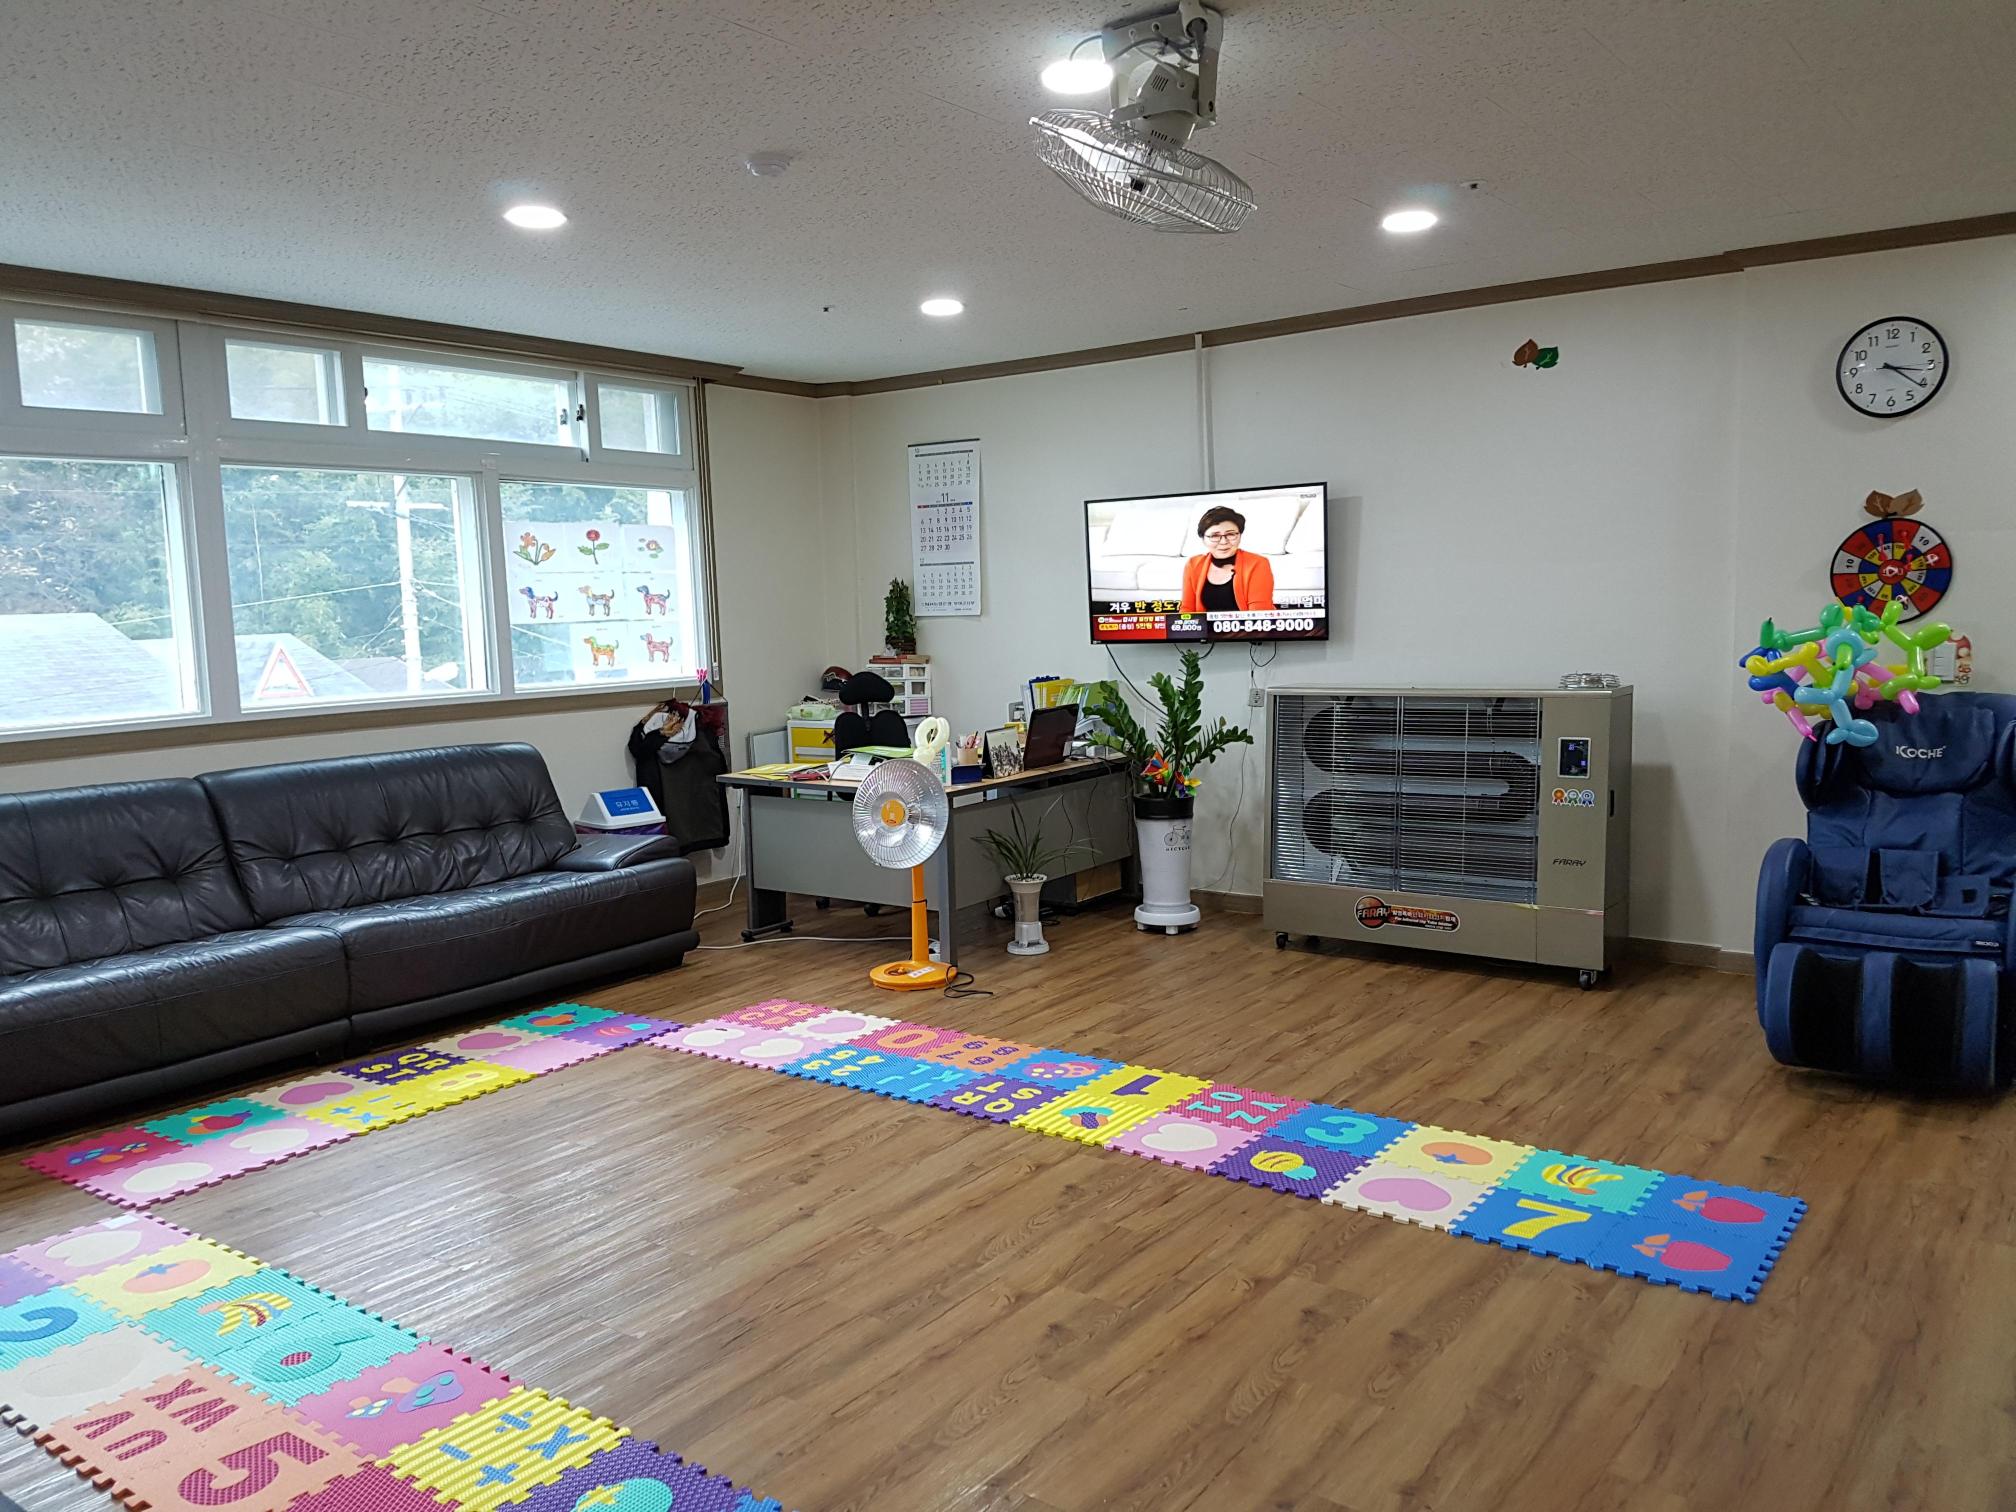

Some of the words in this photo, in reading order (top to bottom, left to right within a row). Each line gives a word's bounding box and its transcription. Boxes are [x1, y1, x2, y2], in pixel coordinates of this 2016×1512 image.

[1886, 328, 1900, 340] 12
[1910, 332, 1915, 342] 1
[1868, 336, 1879, 347] 11
[1922, 342, 1931, 353] 2
[1855, 350, 1867, 361] 10
[1928, 360, 1936, 370] 3
[1850, 368, 1858, 378] 9
[1920, 377, 1928, 388] 4
[1855, 384, 1863, 394] 8
[1868, 394, 1876, 404] 7
[1905, 390, 1914, 401] 5
[1886, 396, 1896, 407] 6
[942, 493, 949, 502] 11
[1135, 600, 1146, 613] 반
[1896, 745, 1944, 759] KOCHE
[828, 1050, 857, 1060] 5
[857, 1055, 885, 1064] 4
[398, 1053, 429, 1065] Q
[416, 1058, 450, 1070] R
[802, 1060, 831, 1070] 3
[360, 1064, 392, 1073] S
[385, 1068, 418, 1079] T
[831, 1065, 862, 1076] 2
[976, 1081, 1005, 1093] T
[952, 1091, 987, 1105] R
[1011, 1088, 1042, 1099] S
[984, 1098, 1014, 1113] Q
[1250, 1100, 1287, 1112] Y
[1226, 1110, 1267, 1124] Z
[1305, 1116, 1379, 1144] 3
[1502, 1199, 1592, 1239] 7
[74, 1411, 136, 1440] V
[104, 1430, 168, 1461] U
[177, 1431, 330, 1506] 5
